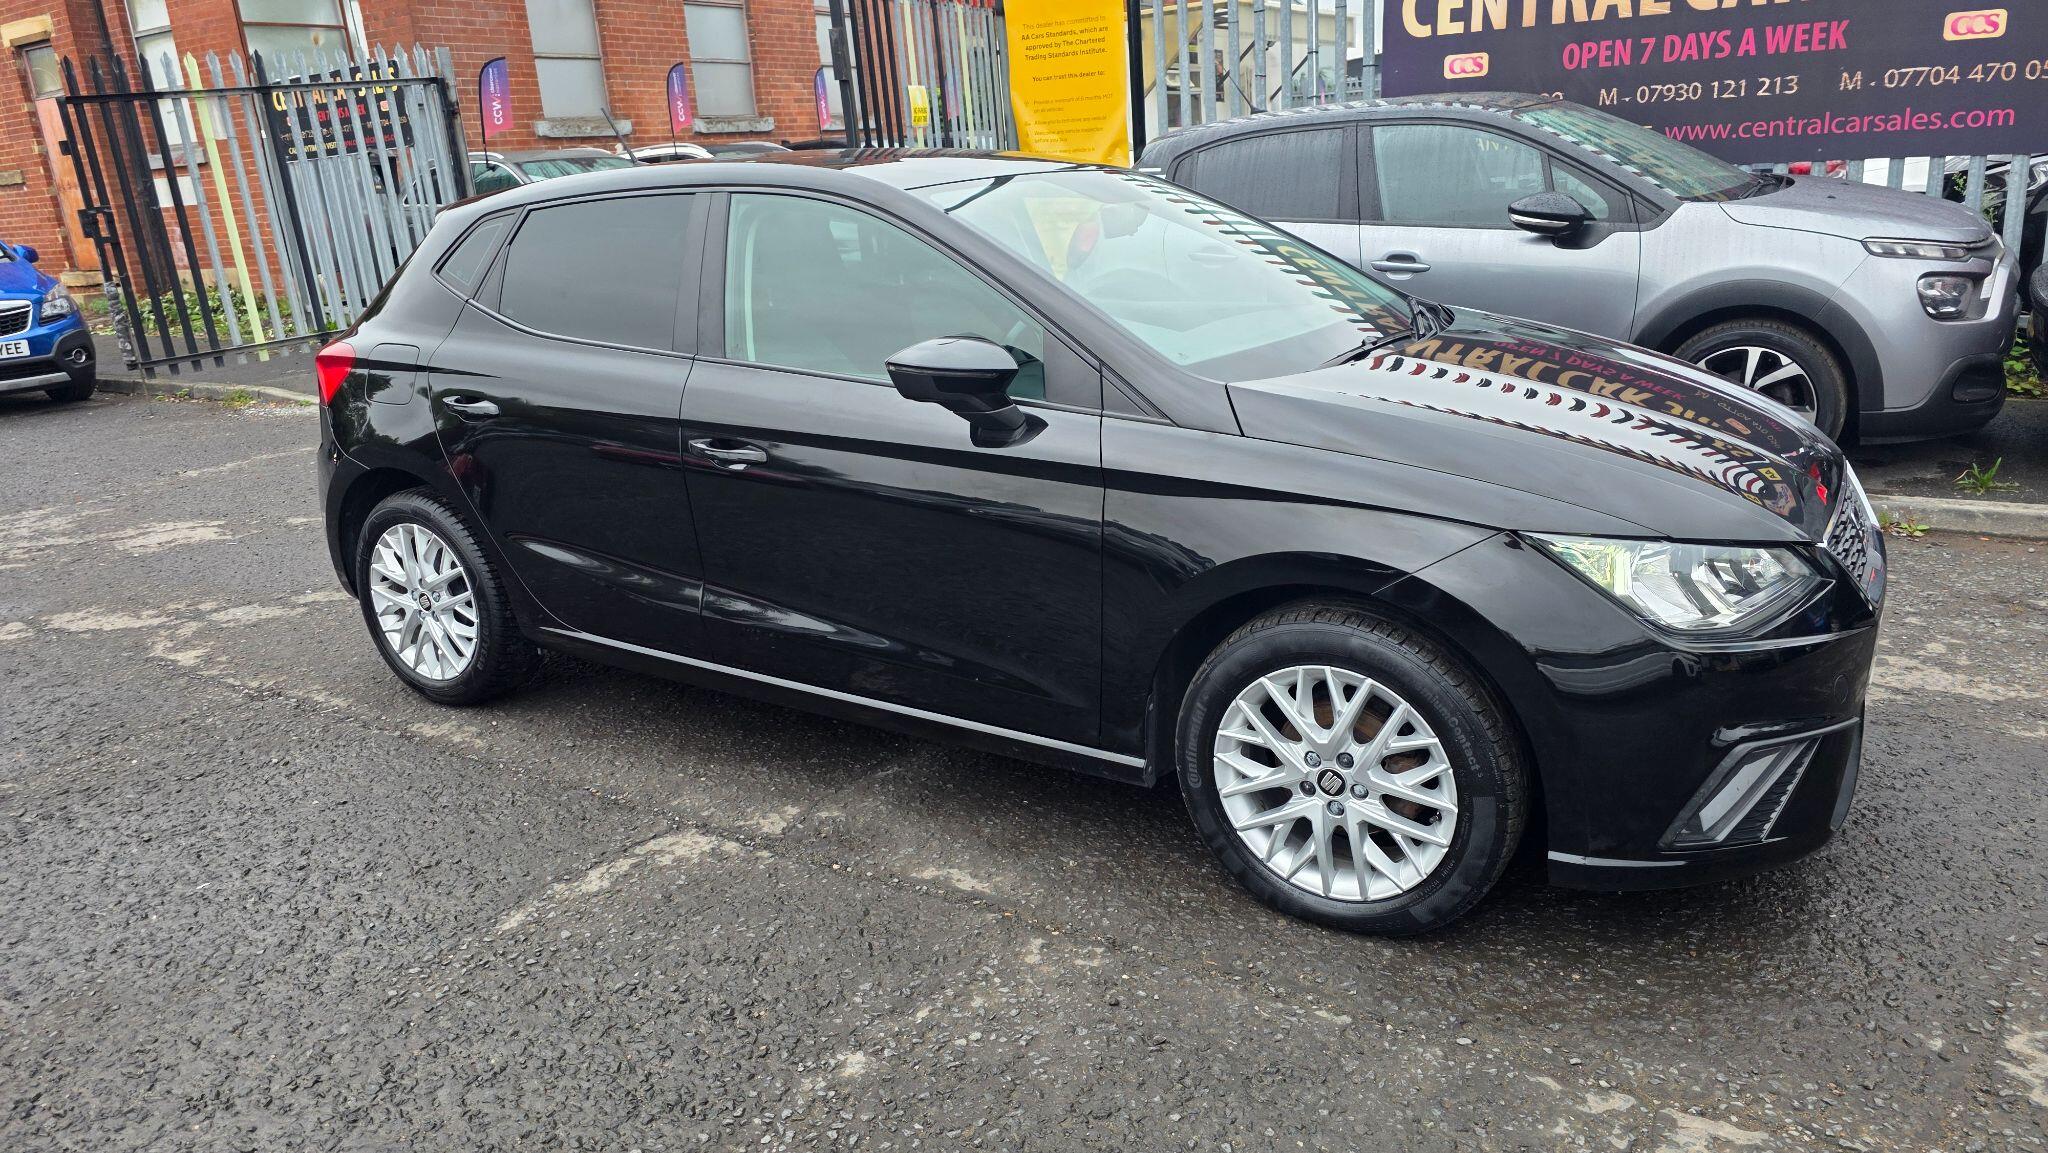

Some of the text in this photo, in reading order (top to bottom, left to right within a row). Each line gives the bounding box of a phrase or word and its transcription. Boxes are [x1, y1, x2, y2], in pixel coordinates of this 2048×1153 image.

[1036, 21, 1054, 29] dealer
[1079, 26, 1097, 34] which
[1025, 42, 1052, 51] approved
[1075, 36, 1106, 46] Chartered
[1048, 50, 1078, 59] Standards
[1562, 19, 1850, 71] OPEN 7 DAYS A WEEK
[1839, 70, 1862, 91] M
[1884, 65, 1961, 89] 07704
[1966, 61, 2017, 82] 470
[1599, 88, 1617, 106] M
[1636, 82, 1702, 104] 07930
[1711, 79, 1746, 99] 121
[1757, 75, 1800, 96] 213
[1664, 107, 2015, 140] www.centralcarsales.com
